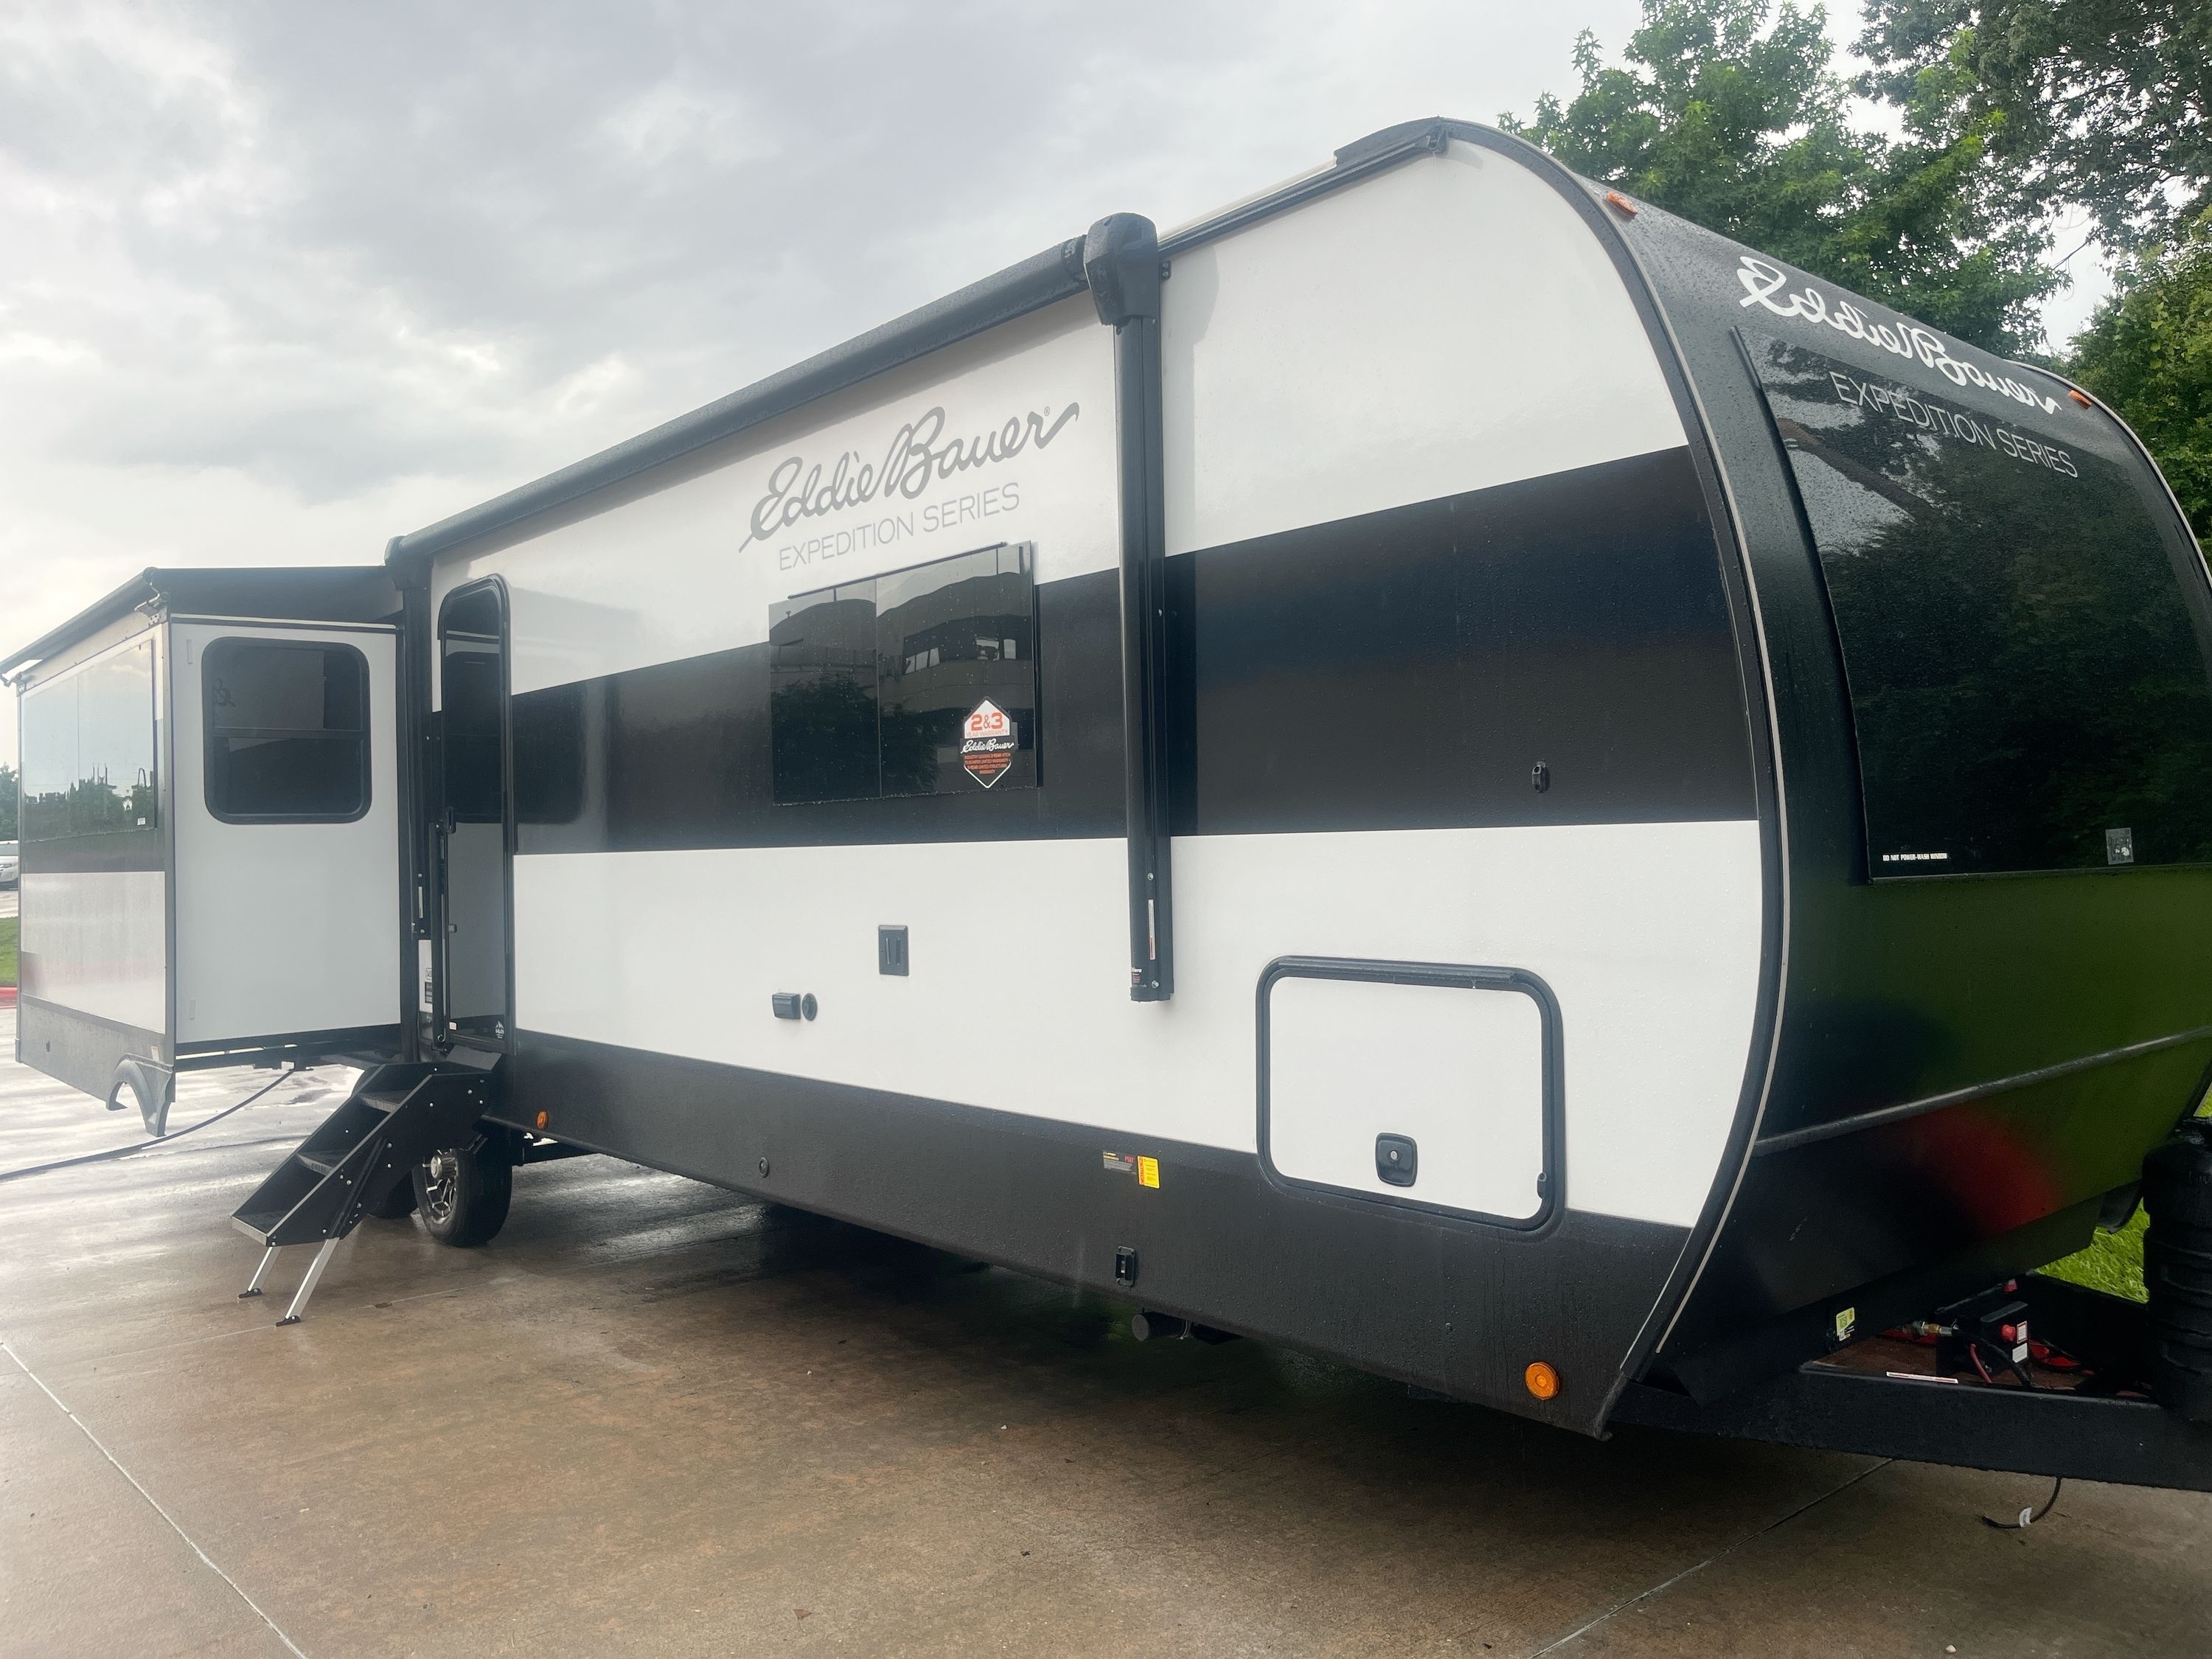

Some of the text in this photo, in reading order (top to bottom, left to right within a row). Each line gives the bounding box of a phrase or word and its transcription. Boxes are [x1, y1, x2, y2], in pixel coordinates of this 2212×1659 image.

[1736, 256, 2062, 414] Eddie Bauer
[1829, 371, 2079, 479] EXPEDITION SERIES
[738, 451, 877, 554] Eddie
[778, 481, 1020, 571] EXPEDITION SERIES
[960, 738, 1015, 754] Eddie Bauer
